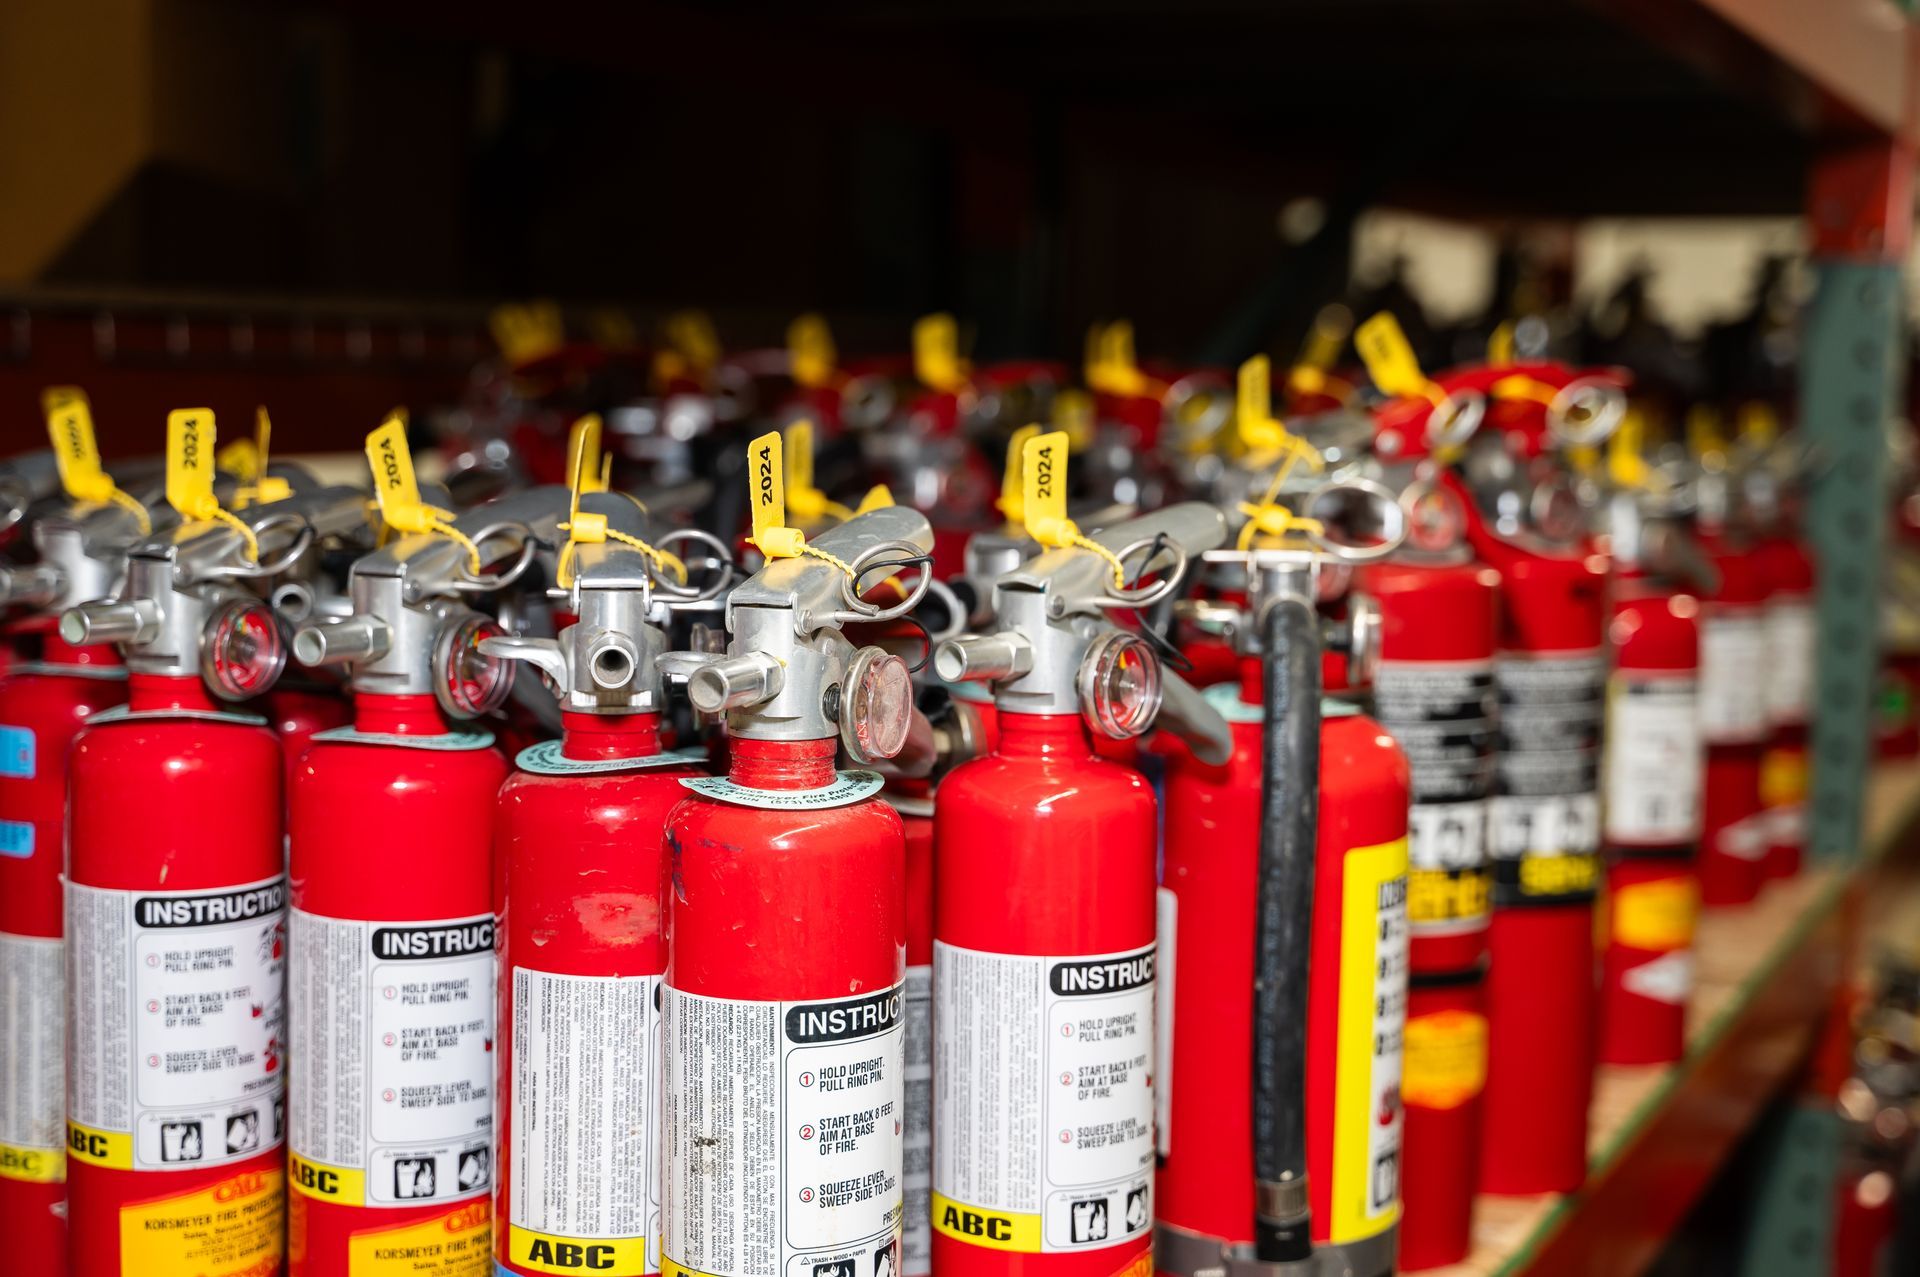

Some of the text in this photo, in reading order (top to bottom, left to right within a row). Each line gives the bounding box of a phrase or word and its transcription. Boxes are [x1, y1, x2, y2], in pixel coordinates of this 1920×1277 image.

[184, 417, 198, 470] 2024
[380, 436, 402, 490] 2024
[1038, 446, 1053, 499] 2024
[762, 445, 772, 507] 2024
[165, 951, 191, 961] HOLD
[402, 983, 428, 993] HOLD
[402, 995, 424, 1005] PULL
[402, 1028, 431, 1038] START
[1079, 1019, 1103, 1030] HOLD
[1079, 1031, 1101, 1042] PULL
[1104, 1027, 1122, 1040] RING
[820, 1056, 885, 1080] HOLD UPRIGHT.
[1079, 1065, 1106, 1077] START
[1109, 1060, 1127, 1074] BACK
[820, 1069, 884, 1093] PULL RING PIN.
[1079, 1072, 1128, 1088] AIM AT BASE
[1078, 1089, 1089, 1101] OF
[819, 1115, 851, 1130] START
[853, 1109, 874, 1126] BACK
[875, 1107, 880, 1119] 8
[819, 1122, 875, 1143] AIM AT BASE
[1078, 1122, 1114, 1138] SQUEEZE
[819, 1139, 859, 1156] OF FIRE.
[1077, 1136, 1107, 1150] SWEEP
[291, 1157, 339, 1194] ABC
[819, 1170, 886, 1196] SQUEEZE LEVER.
[819, 1193, 852, 1209] SWEEP
[855, 1187, 873, 1203] SIDE
[875, 1182, 883, 1195] TO
[144, 1214, 213, 1230] KORSMEYER
[943, 1205, 1012, 1241] ABC
[374, 1243, 443, 1260] KORSMEYER
[446, 1238, 467, 1251] FIRE
[528, 1238, 615, 1270] ABC
[833, 1253, 848, 1261] WOOD
[852, 1248, 866, 1257] PAPER
